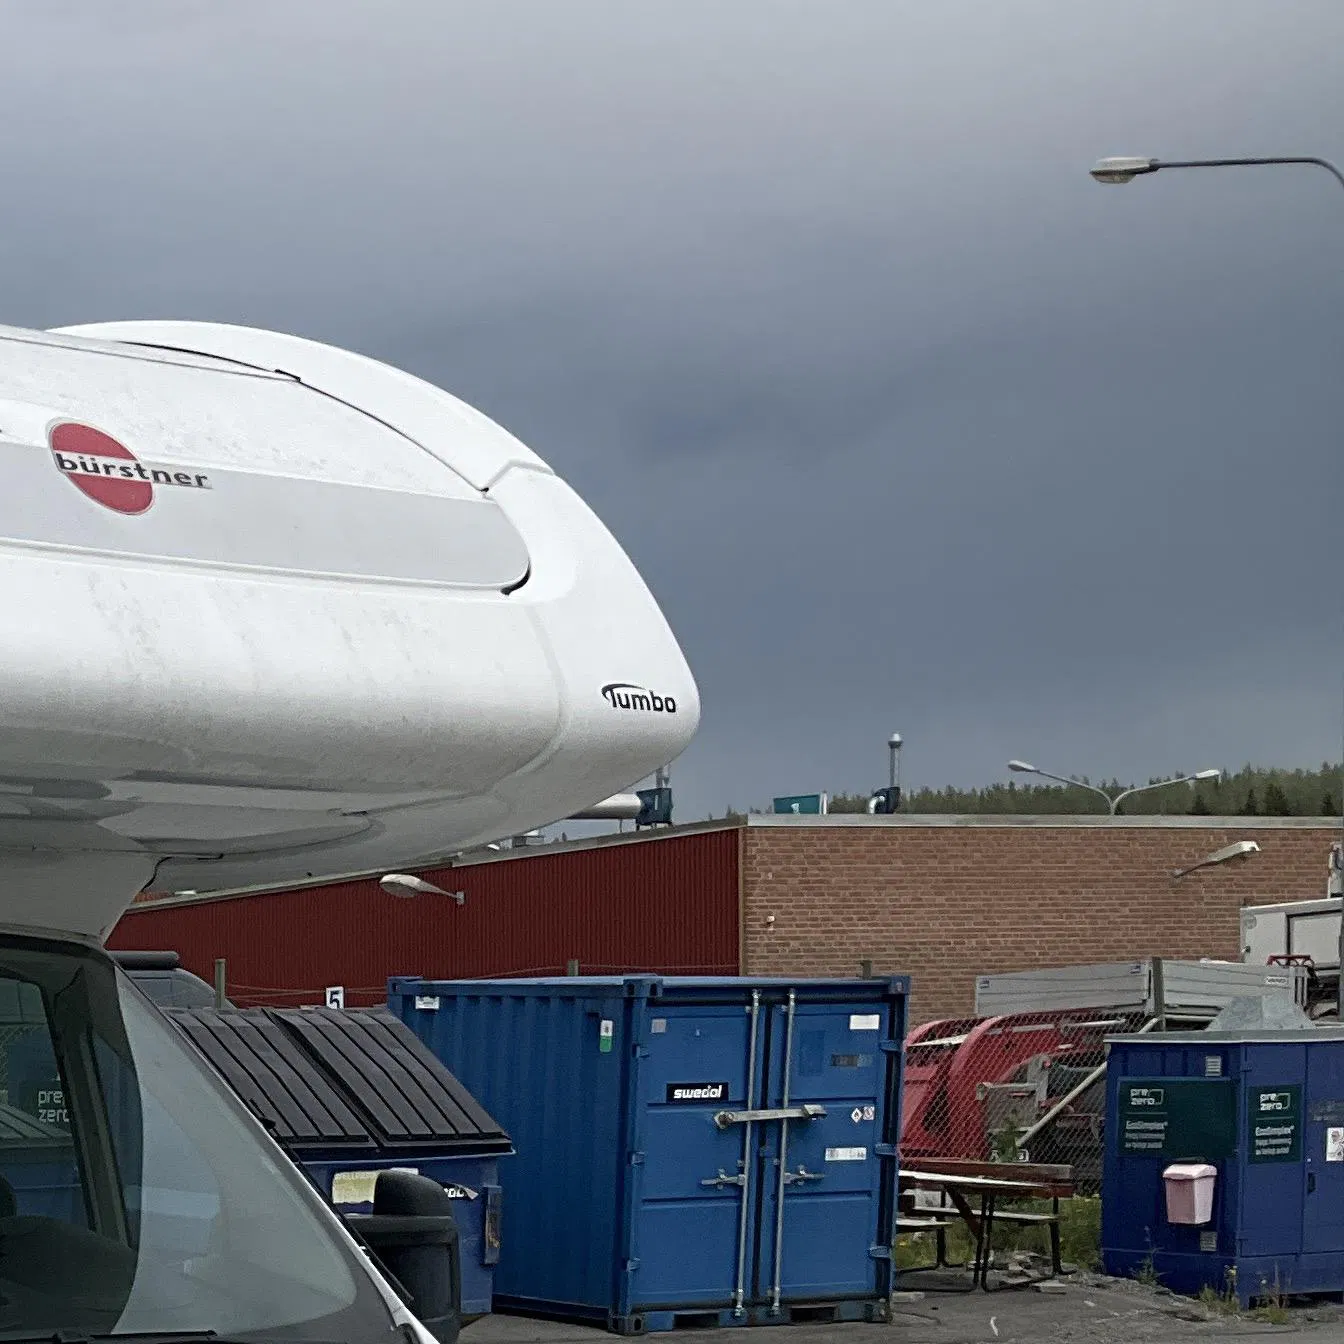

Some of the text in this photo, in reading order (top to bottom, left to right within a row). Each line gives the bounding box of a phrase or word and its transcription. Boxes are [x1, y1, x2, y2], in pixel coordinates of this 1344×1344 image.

[55, 452, 208, 487] bürstner
[601, 683, 676, 713] Tumbo
[330, 990, 340, 1009] 5
